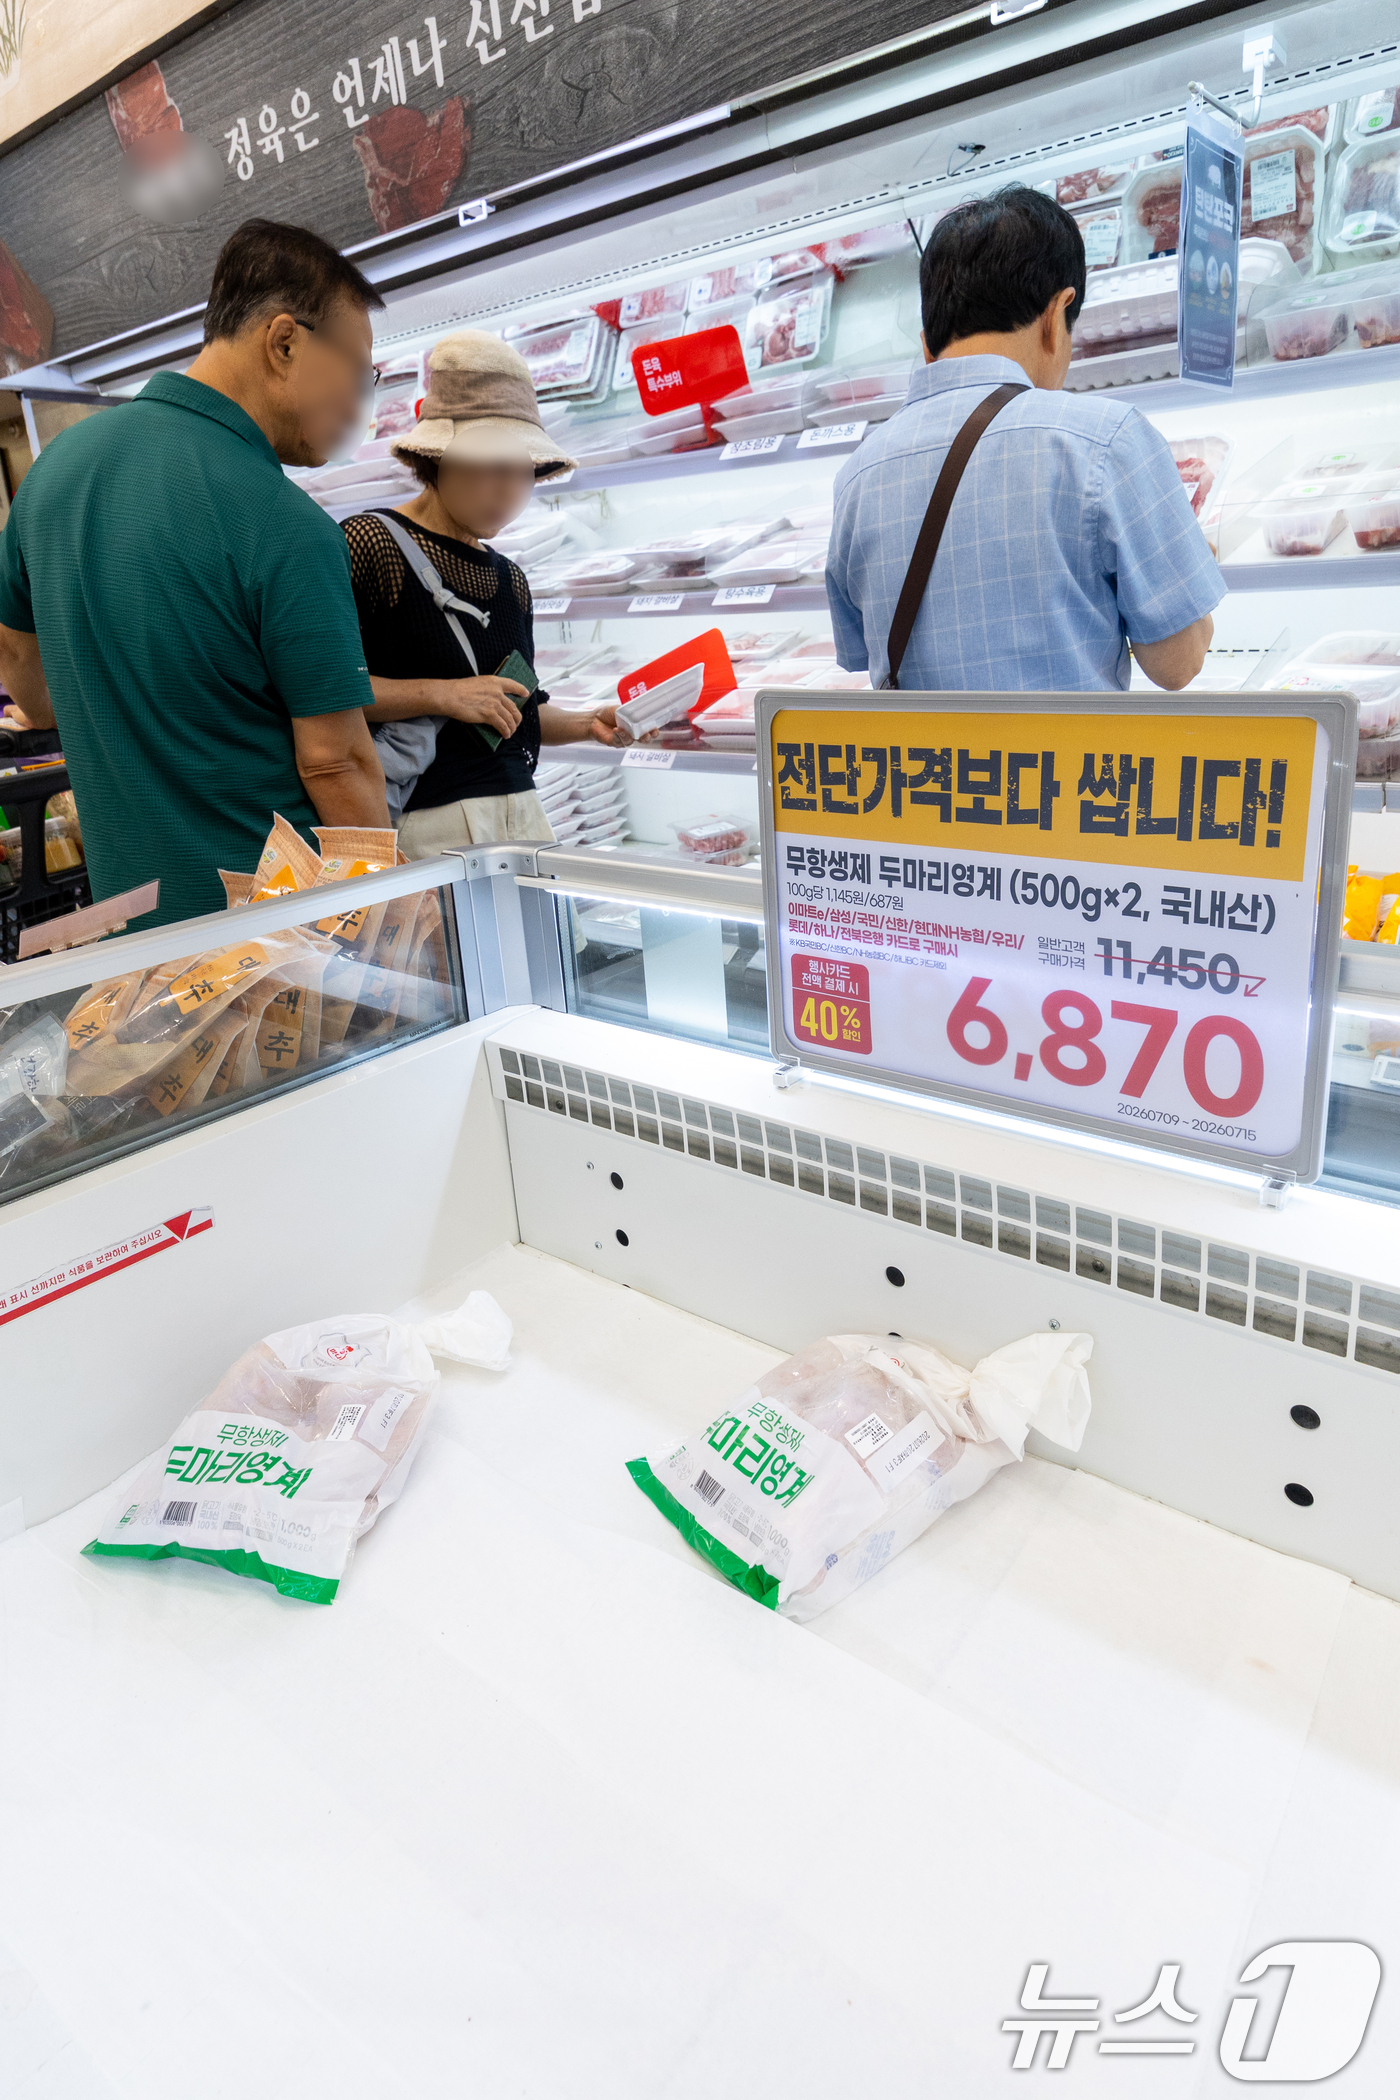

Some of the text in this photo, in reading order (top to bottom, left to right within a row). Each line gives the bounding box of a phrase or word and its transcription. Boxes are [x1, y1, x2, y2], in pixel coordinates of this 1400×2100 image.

[224, 88, 319, 181] 정육은
[332, 17, 447, 130] 언제나
[642, 357, 662, 375] 돈육
[647, 370, 683, 392] 특수부위
[810, 424, 856, 441] 돈까스용
[725, 586, 766, 599] 탕수육용
[776, 742, 1288, 848] 전단가격보다 쌉니다!
[786, 845, 872, 882] 무항생제
[878, 855, 1002, 900] 두마리영계
[1160, 888, 1276, 934] 국내산)
[786, 882, 904, 912] 100g당 1,145원/687원
[788, 918, 958, 958] 롯데/하나/전북은행 카드로 구매시
[1038, 936, 1085, 955] 일반고객
[808, 959, 850, 979] 행사카드
[1038, 953, 1085, 970] 구매가격
[1097, 937, 1240, 995] 11,450
[801, 972, 859, 995] 전액 결제 시
[842, 1028, 861, 1042] 할인
[947, 977, 1264, 1118] 6,870
[1117, 1102, 1180, 1126] 20260709
[1191, 1117, 1257, 1142] 20260715
[10, 1290, 28, 1304] 표시
[30, 1273, 66, 1295] 선까지만
[68, 1260, 94, 1276] 식품을
[96, 1244, 129, 1265] 보관하여
[130, 1229, 163, 1249] 주십시오
[217, 1424, 289, 1448] 무항생제
[747, 1402, 805, 1452] 무항생제
